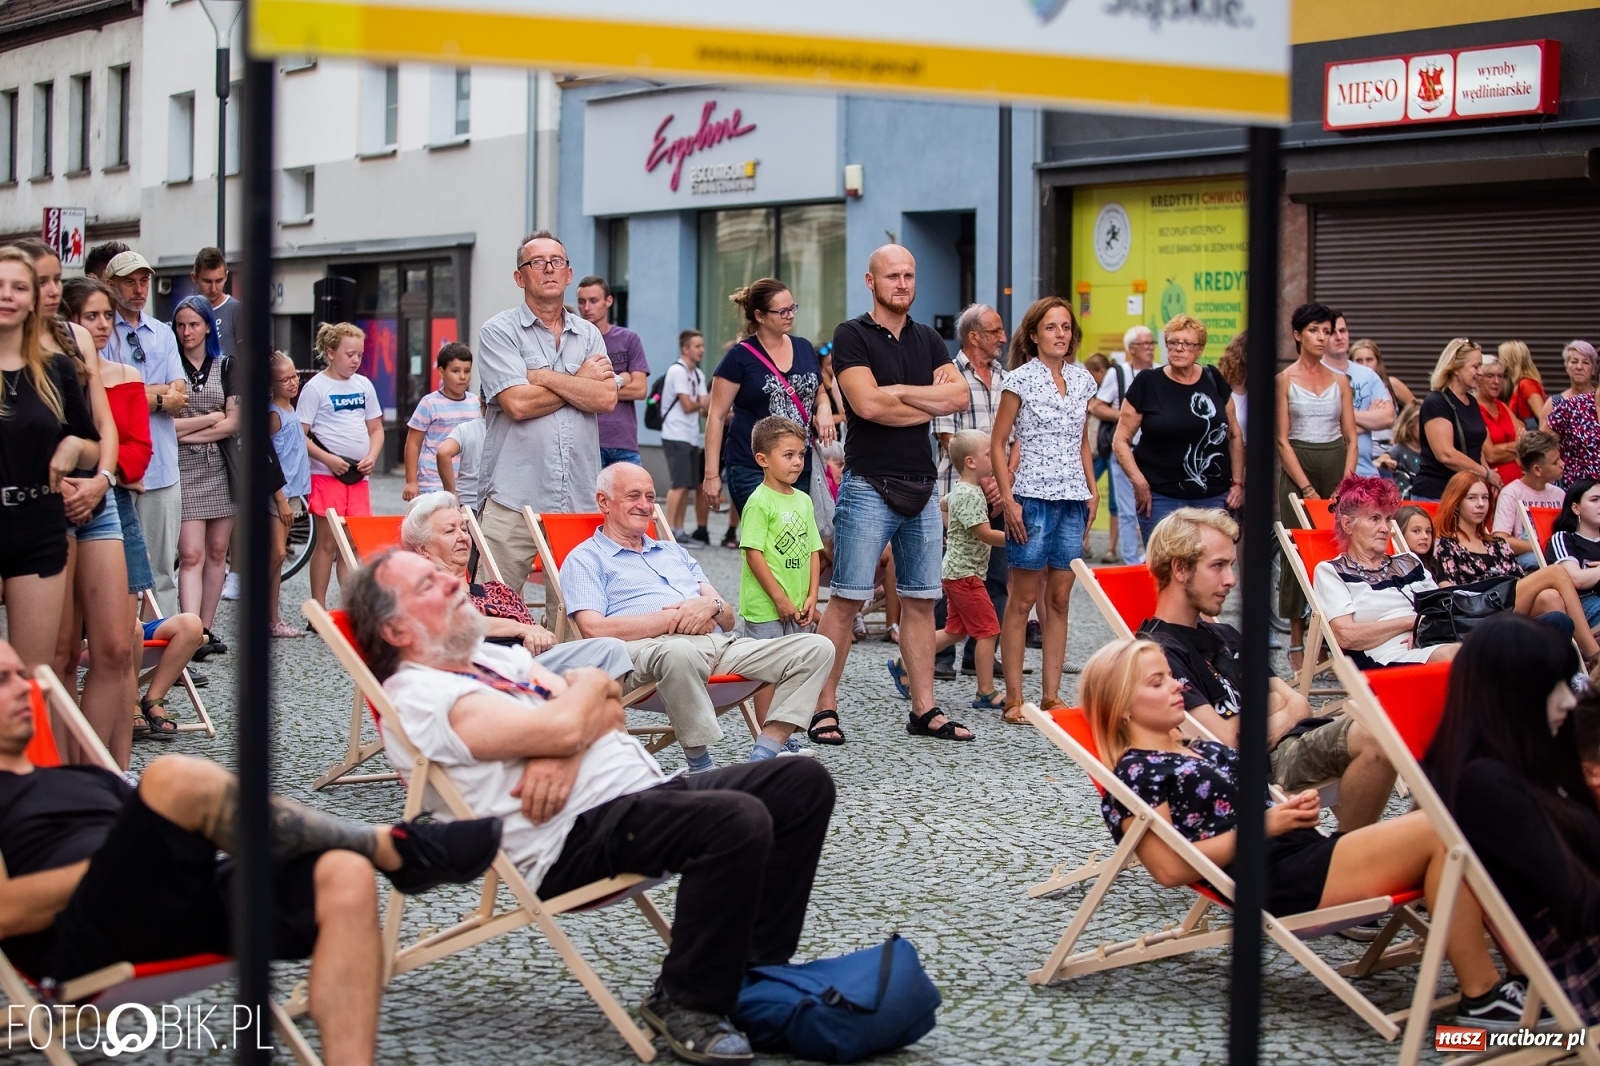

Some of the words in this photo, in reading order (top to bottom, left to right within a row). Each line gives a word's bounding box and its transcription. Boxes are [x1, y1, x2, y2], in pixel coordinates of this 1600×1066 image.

[1478, 61, 1517, 80] wyroby
[1336, 78, 1399, 109] MIĘSO
[1462, 81, 1532, 103] wędliniarskie
[1151, 193, 1194, 208] KREDYTY
[1194, 271, 1249, 292] KREDYT
